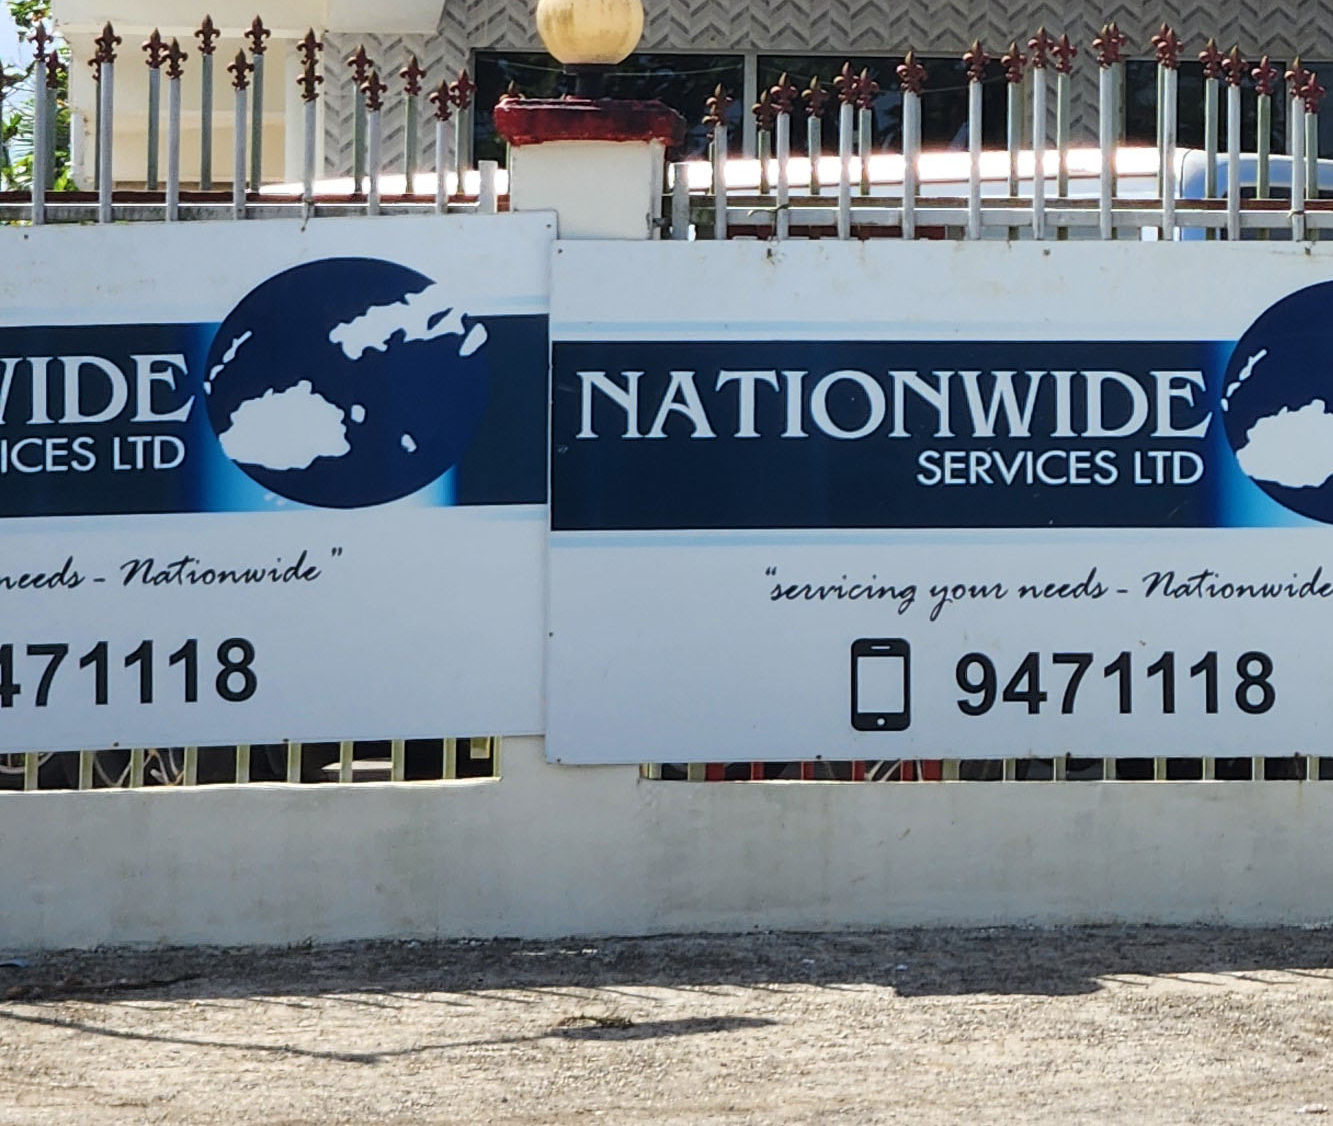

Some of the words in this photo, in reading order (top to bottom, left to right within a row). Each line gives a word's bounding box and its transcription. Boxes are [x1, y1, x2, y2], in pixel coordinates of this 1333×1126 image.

[0, 353, 196, 424] IDE
[574, 368, 1214, 441] NATIONWIDE
[112, 435, 186, 471] LTD
[916, 449, 1120, 487] SERVICES
[1134, 450, 1205, 486] LTD
[930, 580, 1009, 622] your
[1018, 568, 1108, 601] needs
[955, 650, 1277, 716] 9471118
